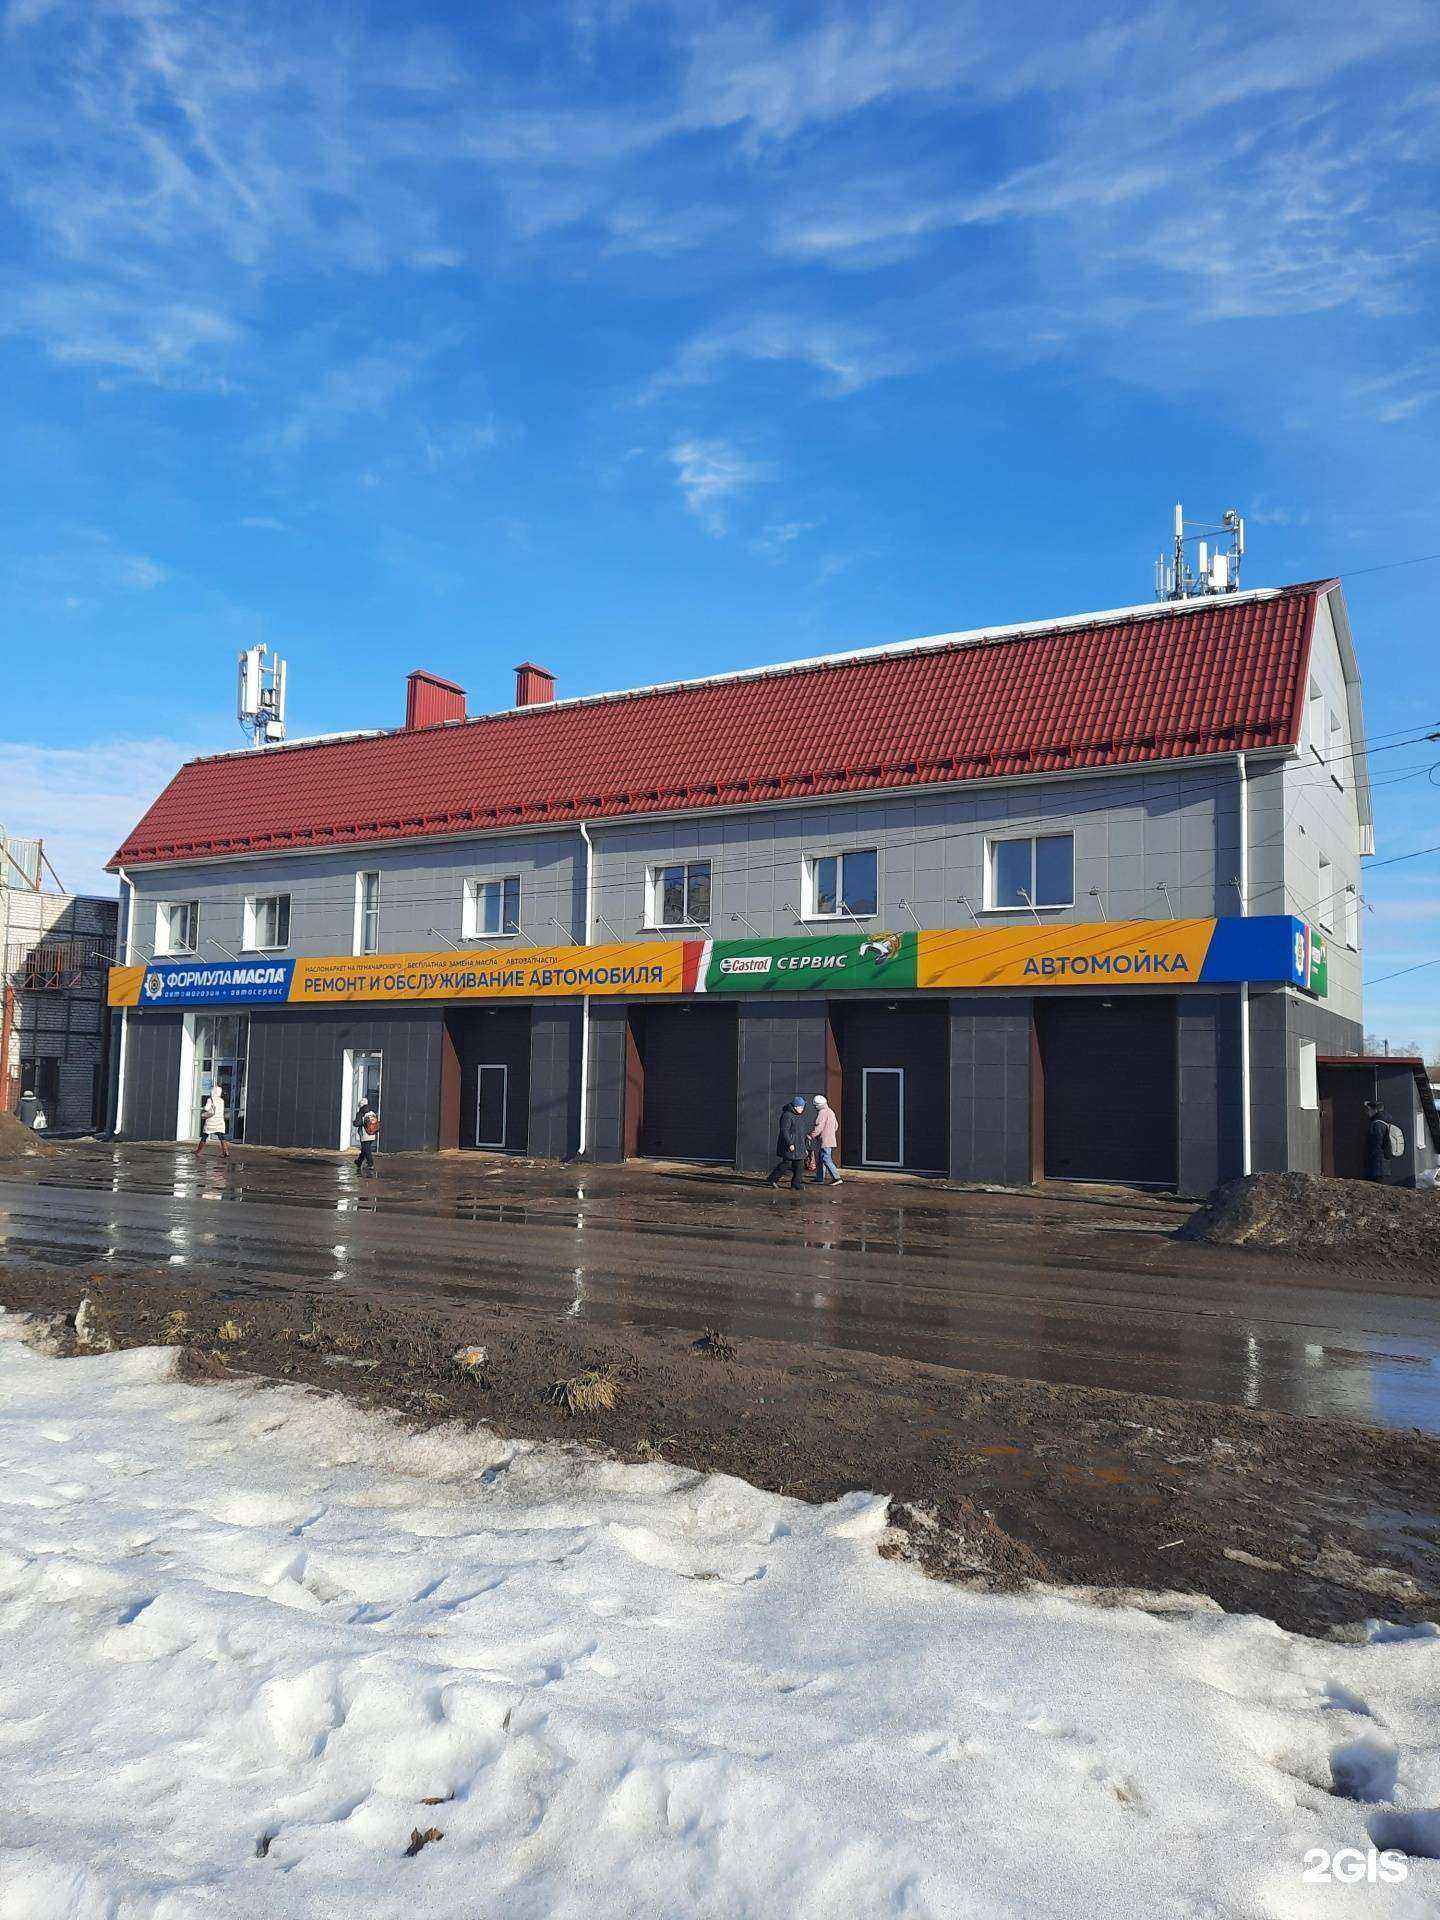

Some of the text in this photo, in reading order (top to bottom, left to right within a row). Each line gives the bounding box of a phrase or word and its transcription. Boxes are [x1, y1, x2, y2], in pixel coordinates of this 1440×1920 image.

[732, 957, 771, 972] Castrol
[776, 955, 848, 970] СЕРВИС
[1023, 949, 1189, 975] АВТОМОЙКА
[304, 965, 663, 992] РЕМОНТ И ОБСЛУЖИВАНИЕ АВТОМОБИЛЯ
